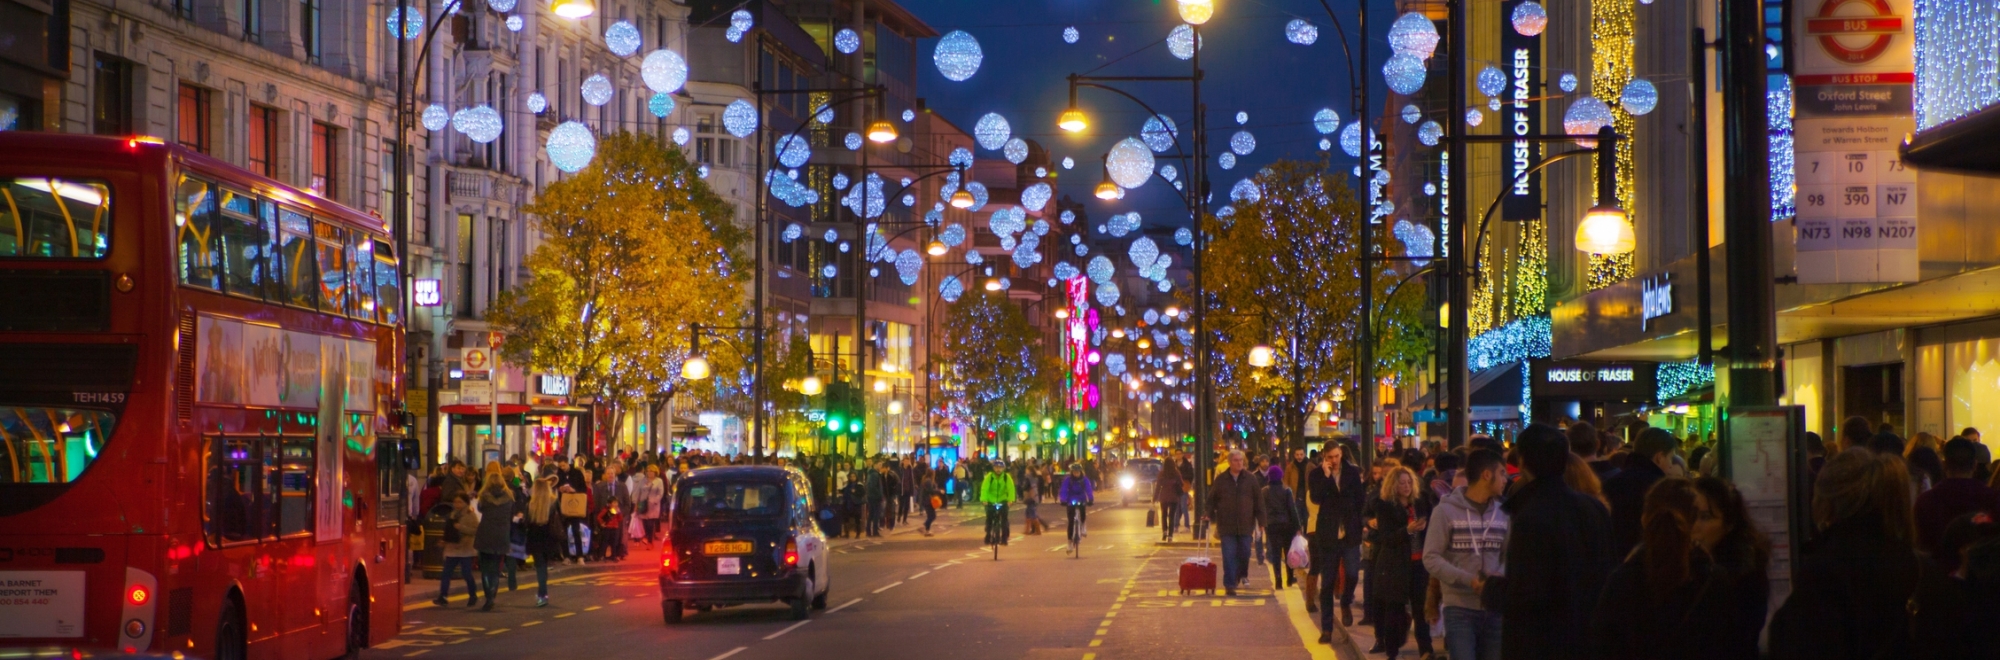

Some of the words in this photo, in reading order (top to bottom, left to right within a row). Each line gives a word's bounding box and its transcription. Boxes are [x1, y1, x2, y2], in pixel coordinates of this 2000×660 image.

[1843, 20, 1868, 31] BUS
[1514, 48, 1529, 109] FRASER
[1831, 76, 1850, 84] BUS
[1853, 75, 1878, 83] STOP
[1817, 91, 1856, 101] Oxford
[1858, 90, 1892, 100] Street
[1833, 104, 1853, 112] John
[1854, 103, 1877, 111] Lewis
[1514, 111, 1529, 136] OF
[1514, 138, 1529, 196] HOUSE
[1811, 161, 1820, 174] 7
[1848, 161, 1864, 173] 10
[1888, 160, 1905, 172] 73
[1807, 194, 1825, 207] 98
[1844, 193, 1870, 206] 390
[1886, 193, 1907, 205] N7
[1801, 227, 1831, 240] N73
[1843, 226, 1872, 239] N98
[1878, 226, 1916, 239] N207
[415, 280, 438, 293] UNI
[415, 292, 440, 306] QLO
[1548, 369, 1582, 382] HOUSE
[1582, 371, 1596, 382] OF
[1597, 368, 1634, 381] FRASER
[73, 392, 125, 403] TEH1459
[0, 589, 32, 597] REPORT
[14, 598, 30, 606] 854
